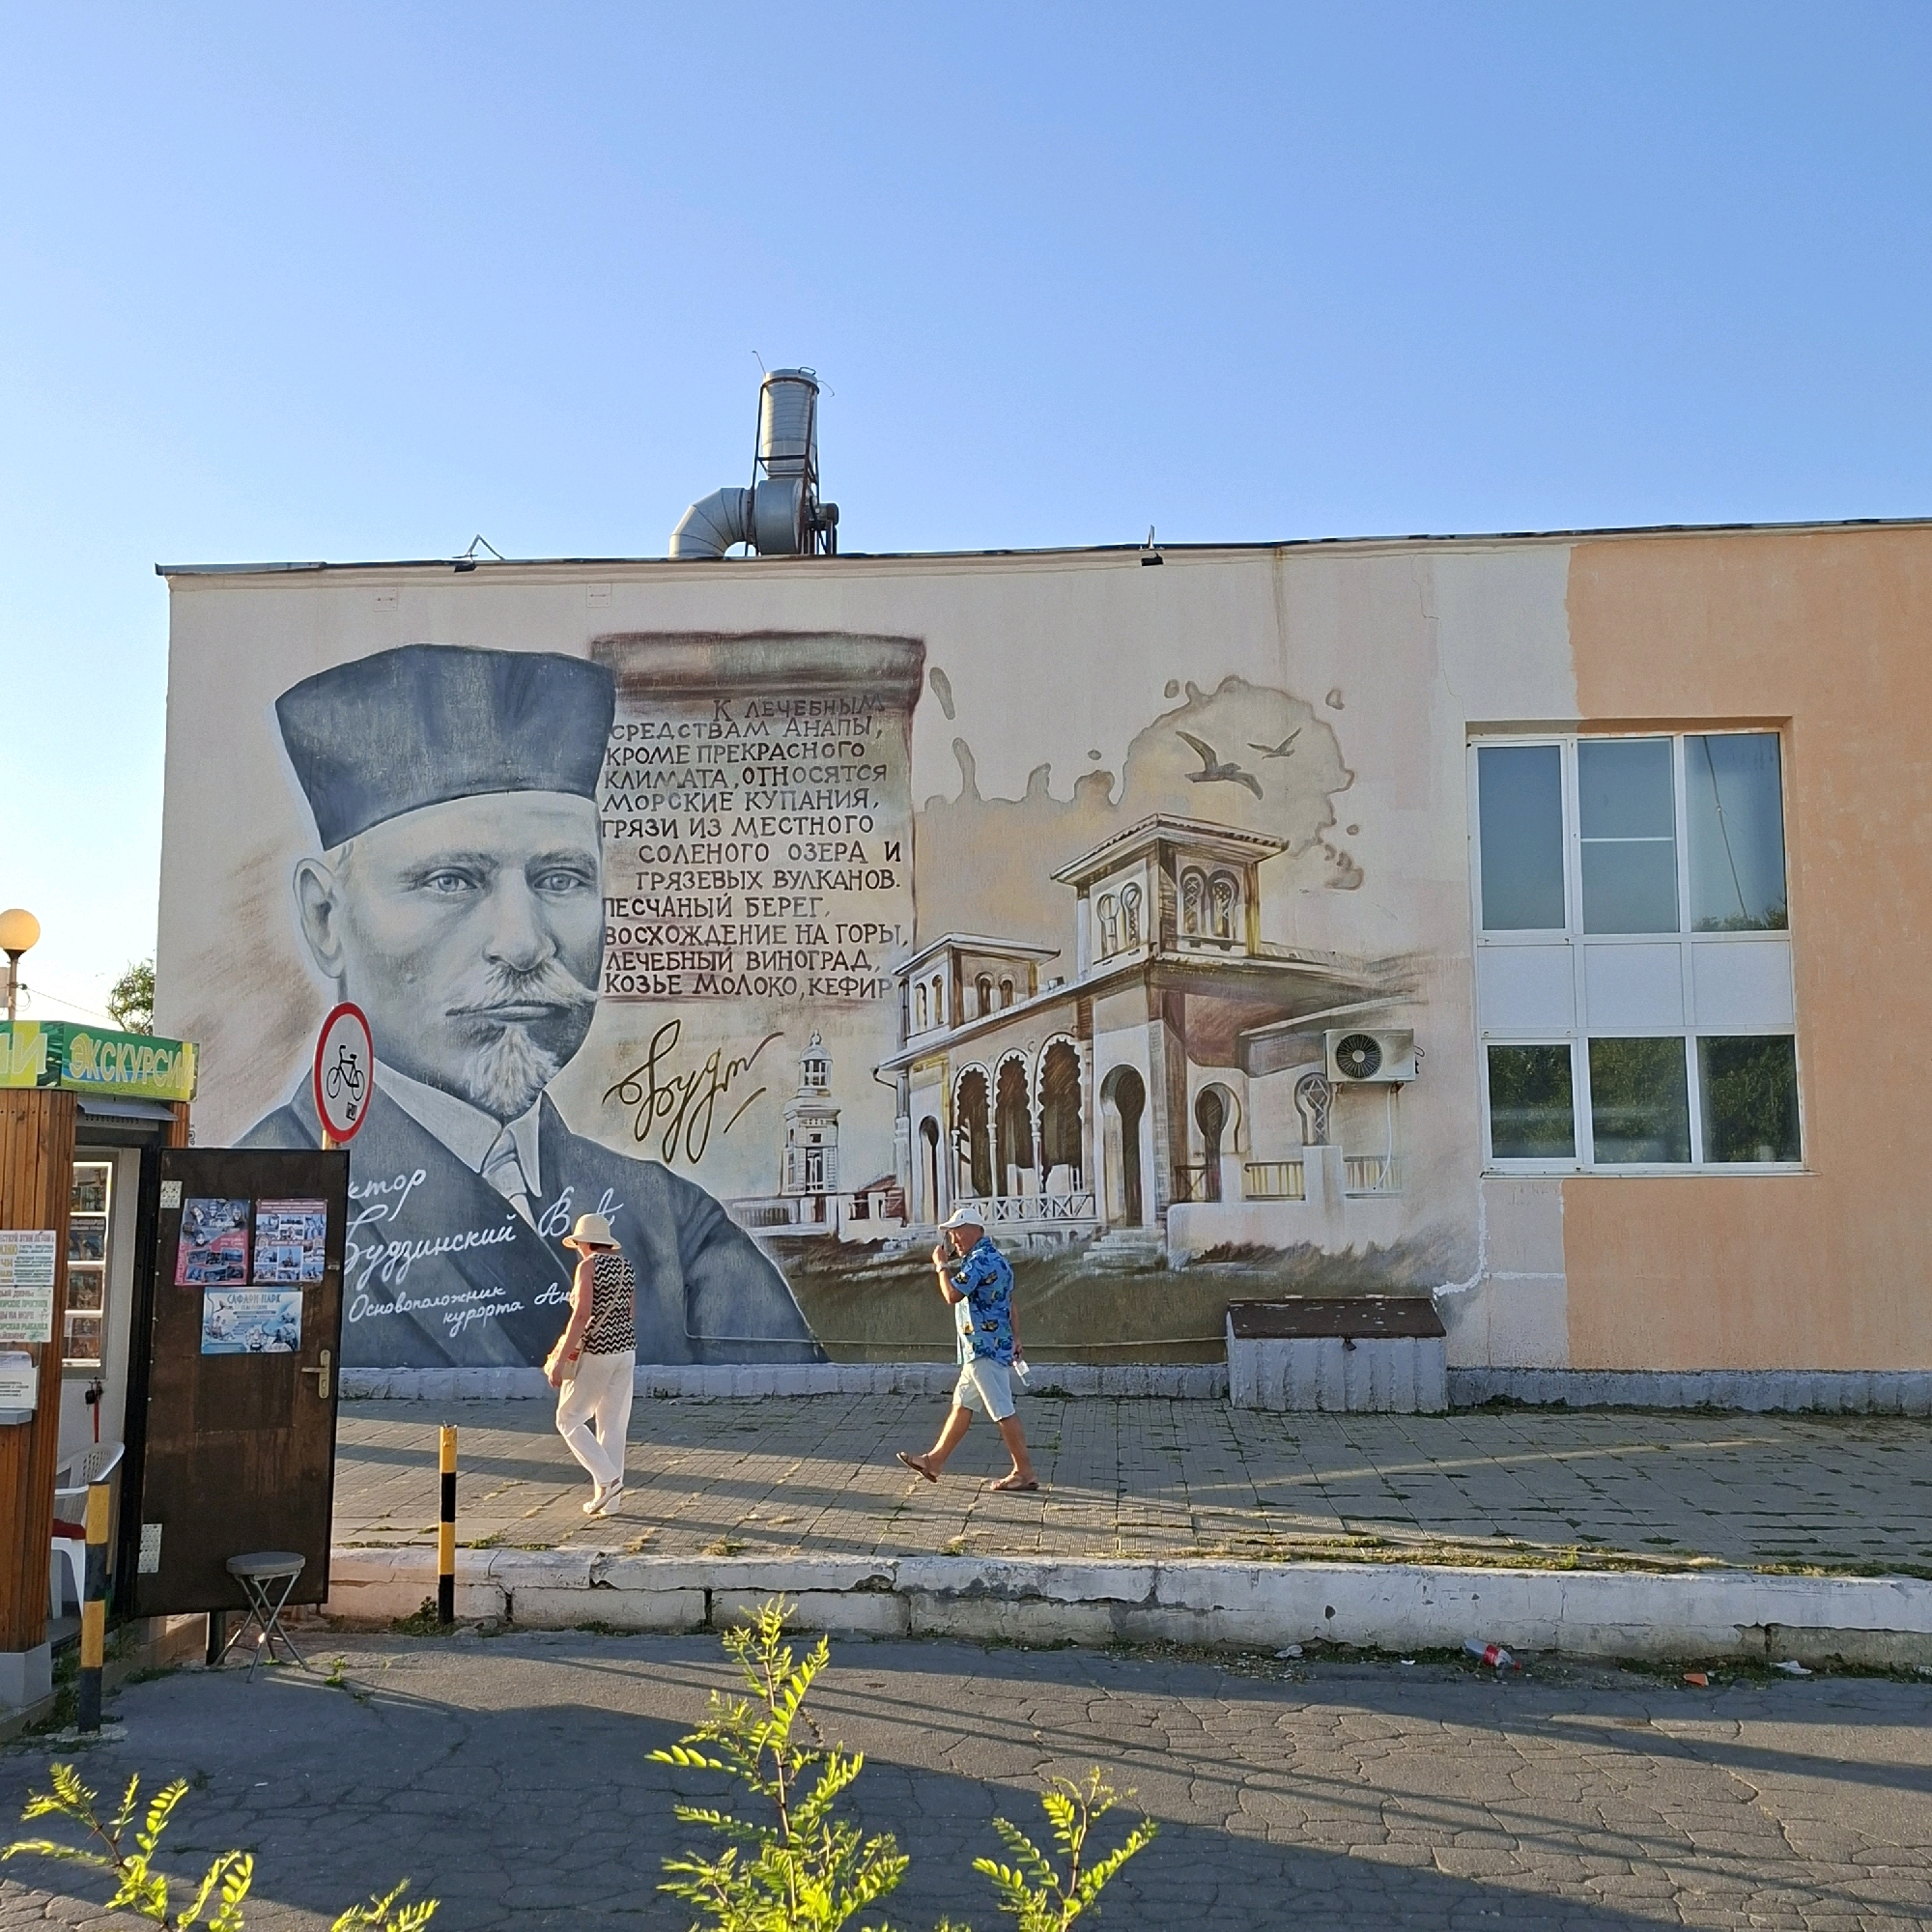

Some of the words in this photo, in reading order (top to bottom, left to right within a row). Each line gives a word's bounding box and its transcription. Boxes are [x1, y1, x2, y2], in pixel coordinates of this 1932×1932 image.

[714, 699, 732, 722] К
[744, 693, 885, 719] ЛЕЧЕБНЫМ
[610, 720, 770, 741] СРЕДСТВАМ
[782, 715, 883, 740] АНАПЫ,
[606, 745, 689, 766] КРОМЕ
[696, 741, 866, 764] ПРЕКРАСНОГО
[602, 791, 733, 813] МОРСКИЕ
[745, 789, 880, 812] КУПАНИЯ,
[602, 818, 679, 839] ГРЯЗИ
[690, 817, 723, 838] ИЗ
[731, 814, 874, 839] МЕСТНОГО
[639, 842, 770, 865] СОЛЕНОГО
[788, 840, 868, 865] ОЗЕРА
[884, 840, 901, 863] И
[636, 868, 763, 892] ГРЯЗЕВЫХ
[772, 868, 901, 891] ВУЛКАНОВ.
[603, 893, 733, 919] ПЕСЧАНЫЙ
[605, 924, 787, 947] ВОСХОЖДЕНИЕ
[796, 923, 830, 945] НА
[836, 923, 909, 948] ГОРЫ,
[606, 948, 733, 973] ЛЕЧЕБНЫЙ
[746, 950, 881, 974] ВИНОГРАД,
[605, 973, 683, 995] КОЗЬЕ
[70, 1034, 196, 1091] ЭКСКУРСИИ
[349, 1287, 507, 1323] Основоположник
[443, 1302, 526, 1338] курорта
